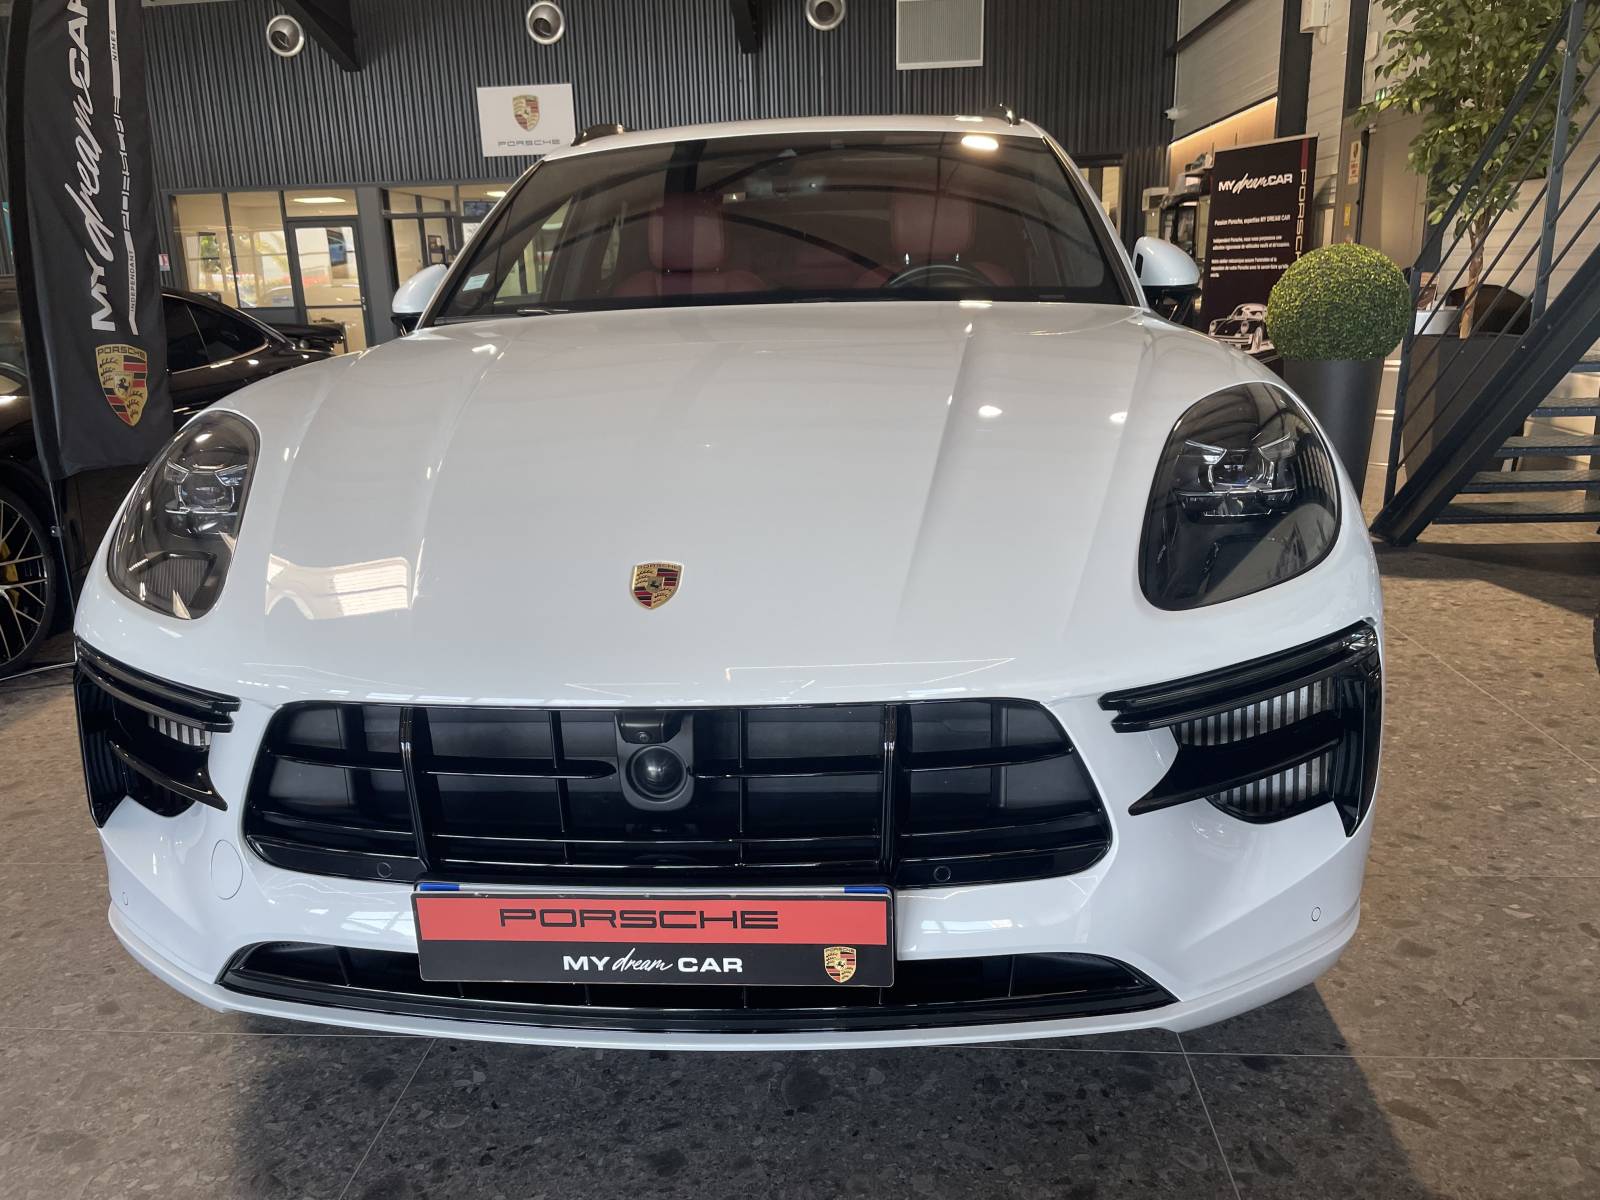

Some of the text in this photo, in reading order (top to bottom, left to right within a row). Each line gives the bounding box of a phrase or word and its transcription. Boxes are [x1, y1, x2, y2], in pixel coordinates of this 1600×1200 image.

[497, 138, 561, 147] PORSCHE
[64, 71, 115, 262] dream
[1218, 180, 1236, 192] MY
[1268, 173, 1293, 186] CAR
[1295, 169, 1307, 261] PORSCH
[84, 248, 116, 332] MY
[97, 345, 146, 359] PORSCHE
[499, 908, 779, 930] PORSCHE
[562, 947, 744, 973] MY dream CAR
